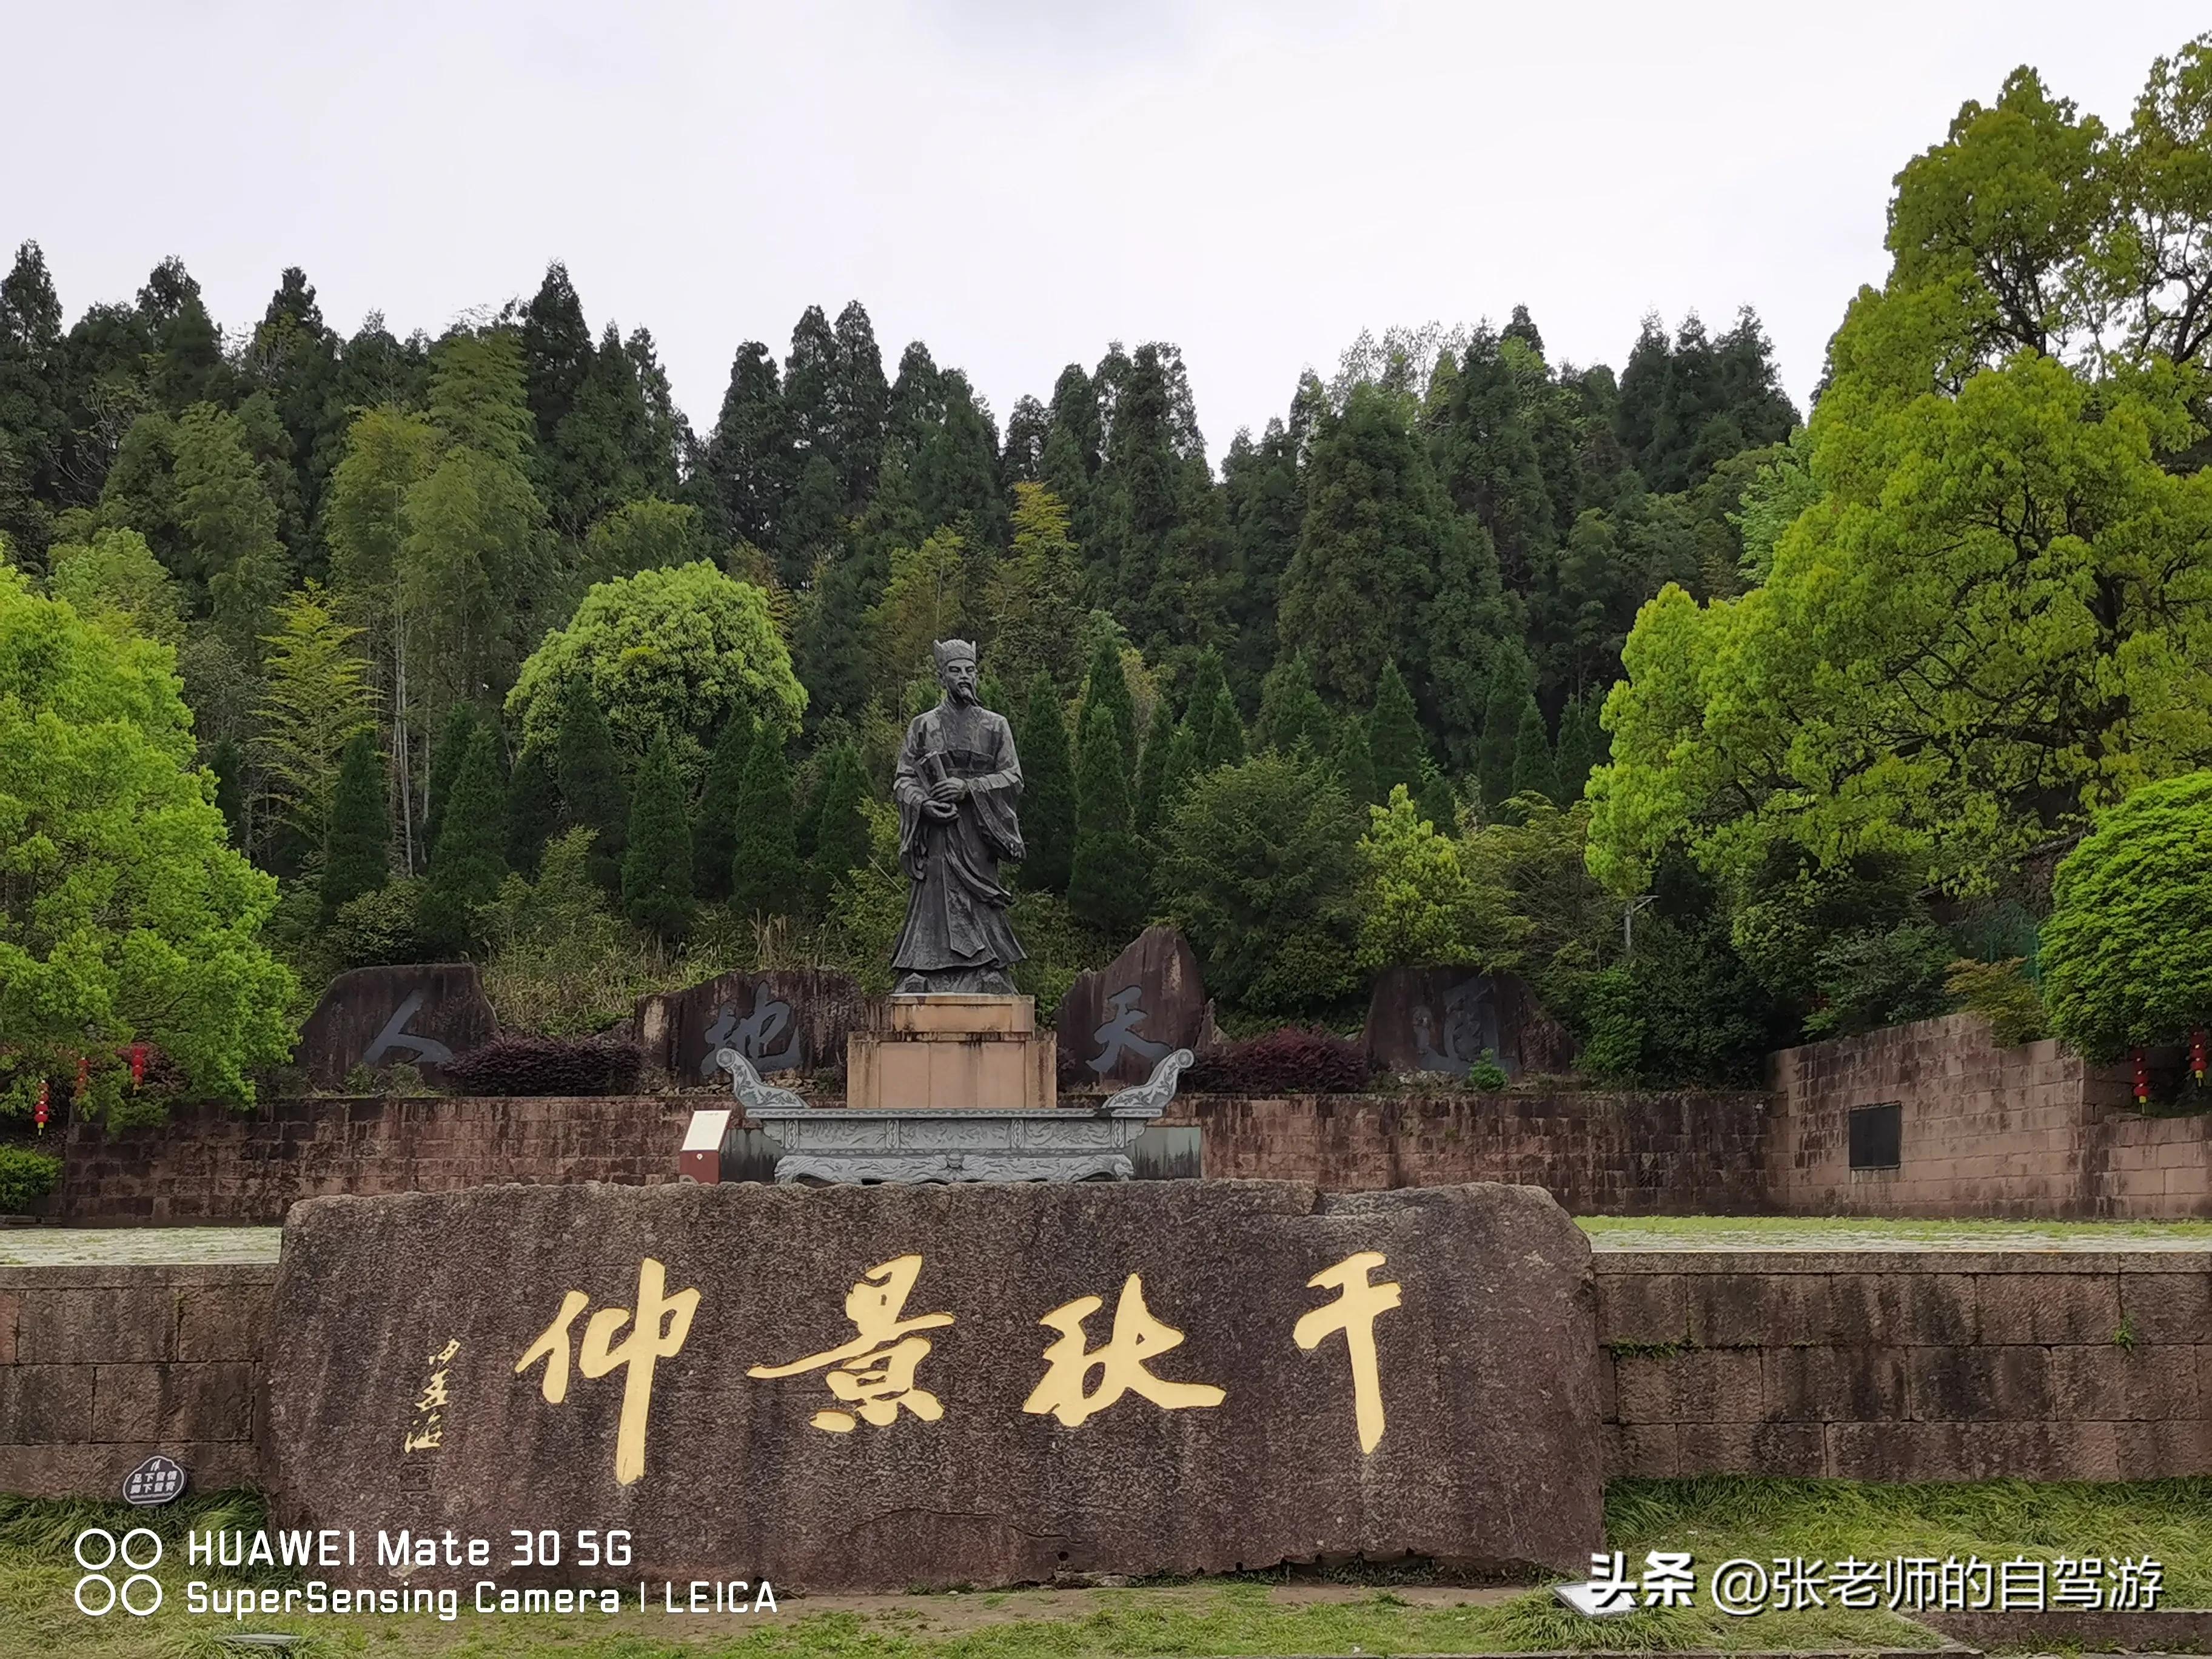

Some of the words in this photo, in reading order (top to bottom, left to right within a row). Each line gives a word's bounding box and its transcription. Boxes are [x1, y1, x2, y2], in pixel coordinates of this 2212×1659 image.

[365, 988, 452, 1064] 人
[701, 981, 802, 1076] 地
[1085, 985, 1173, 1073] 天
